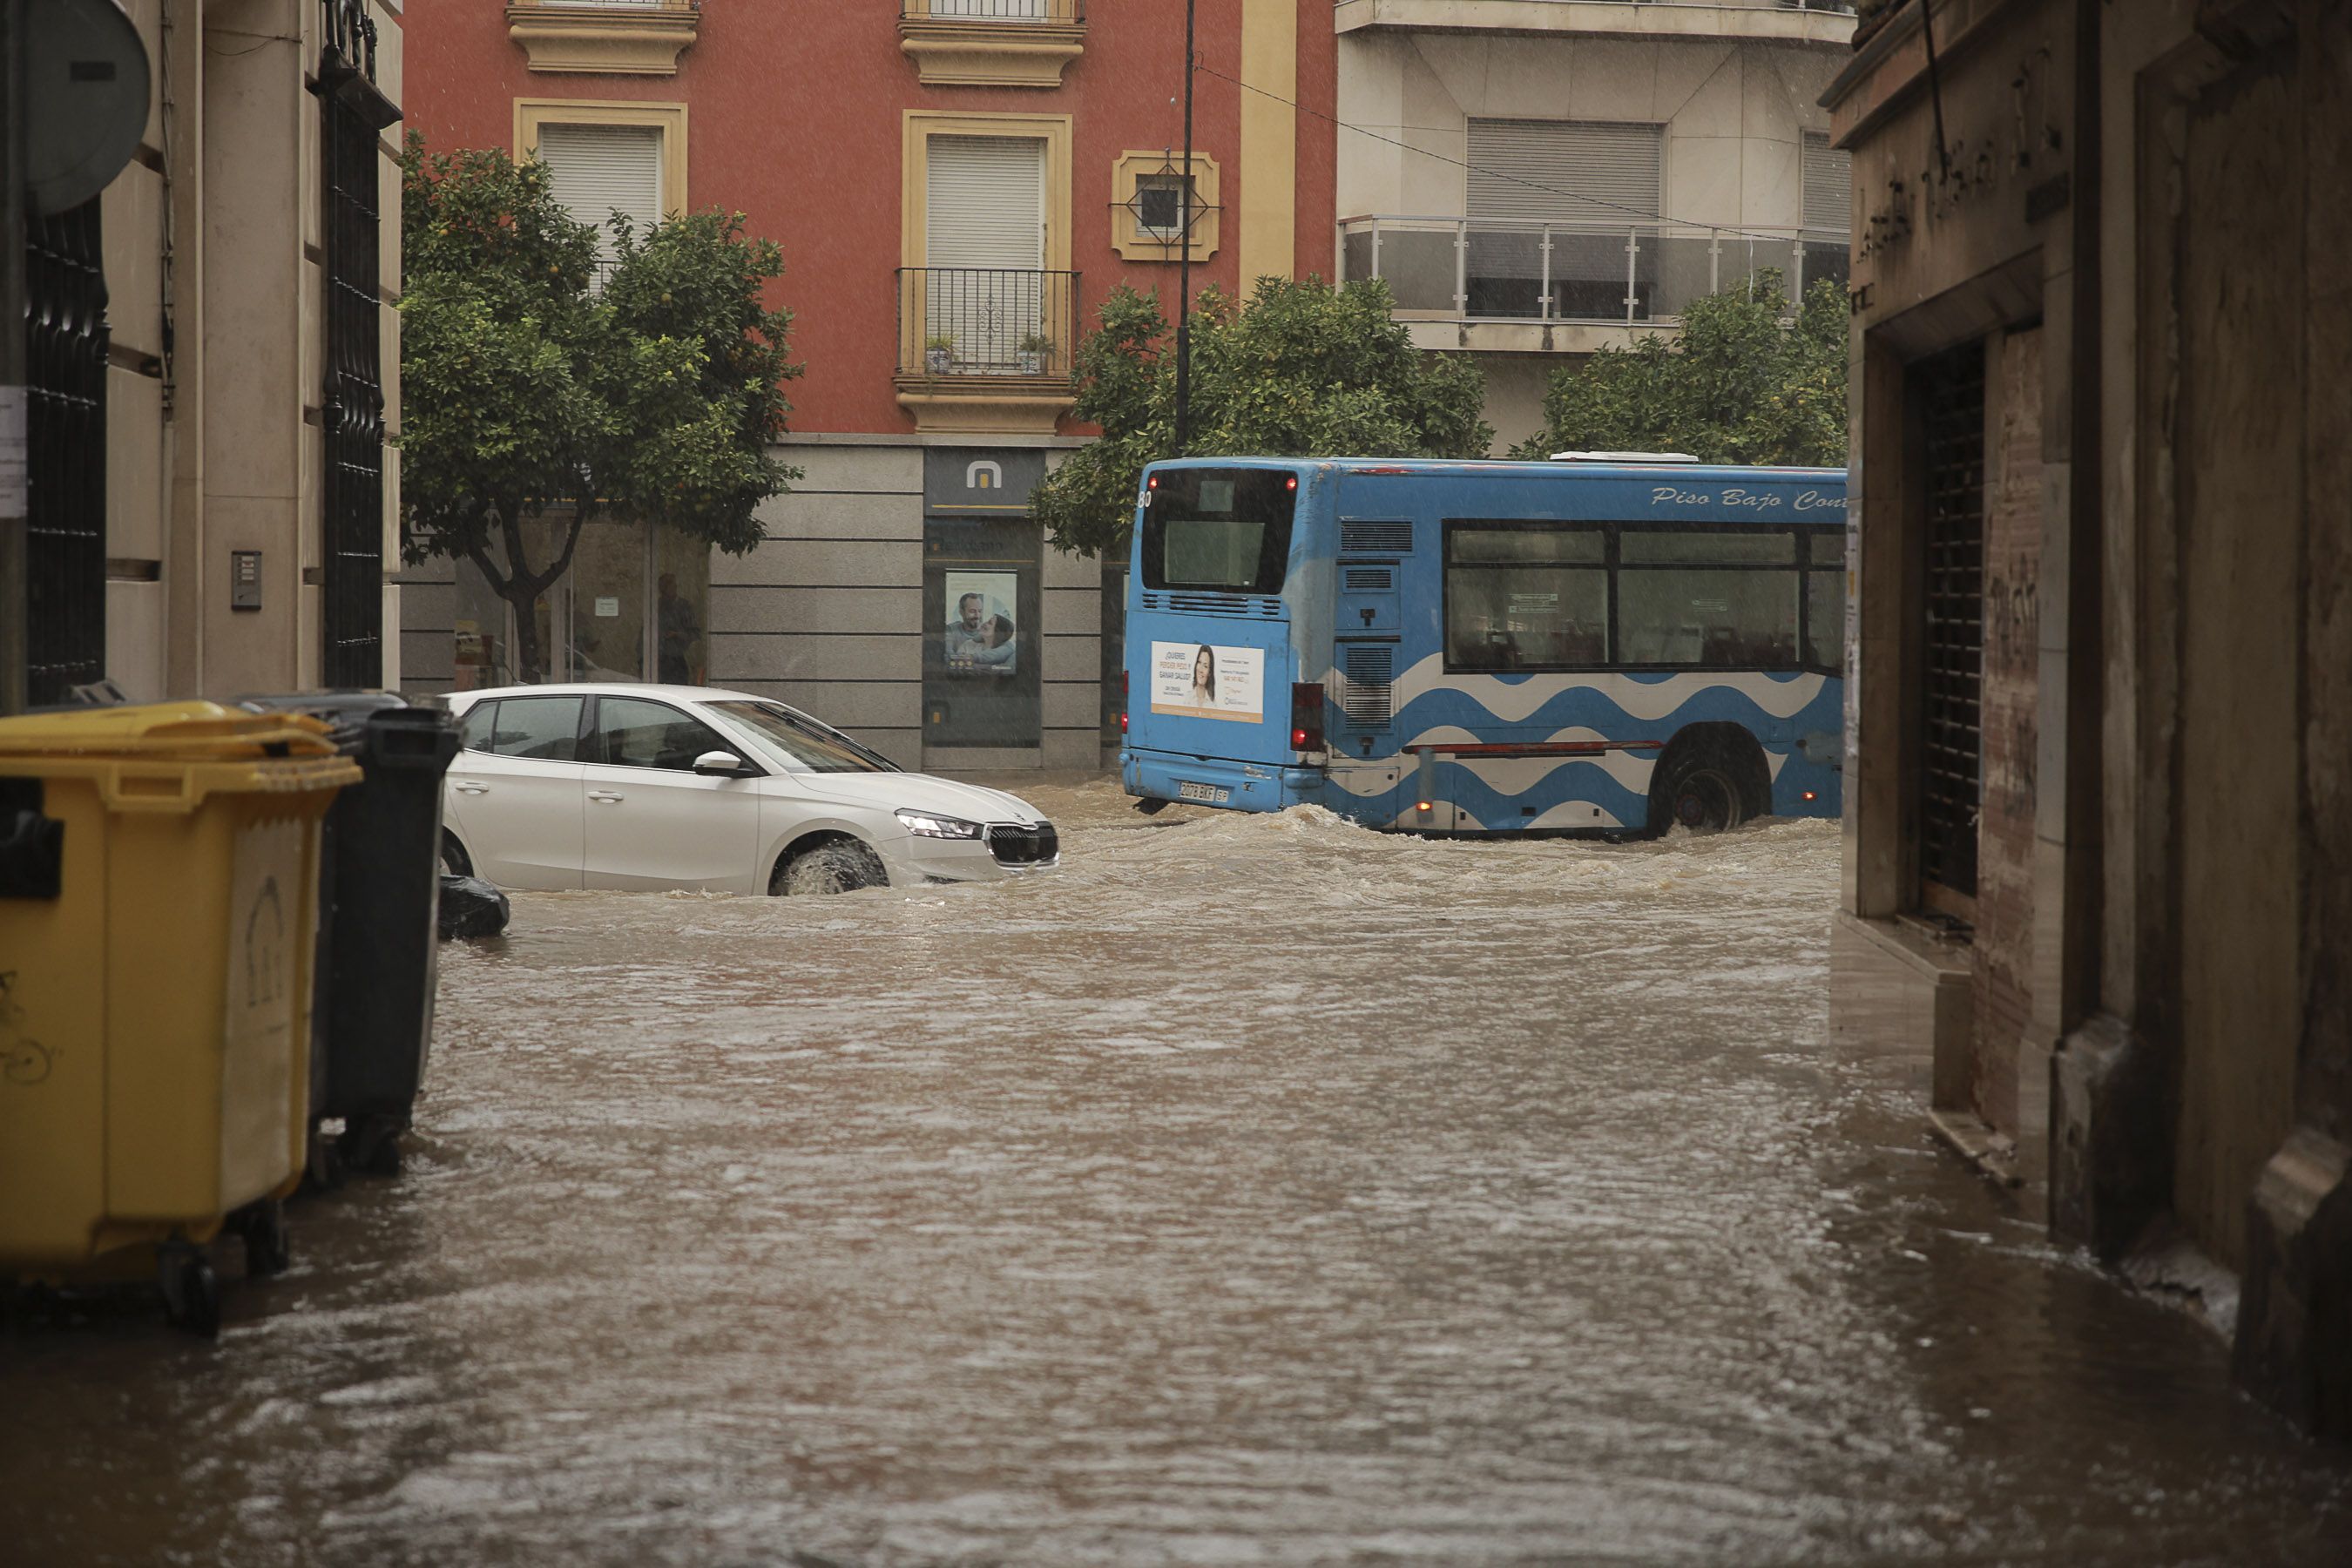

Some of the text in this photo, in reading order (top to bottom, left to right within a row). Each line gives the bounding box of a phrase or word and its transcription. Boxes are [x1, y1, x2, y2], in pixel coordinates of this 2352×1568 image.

[1137, 490, 1152, 509] 80
[1652, 487, 1711, 505] Piso
[1721, 489, 1782, 511] Bajo
[1180, 784, 1199, 797] 2078
